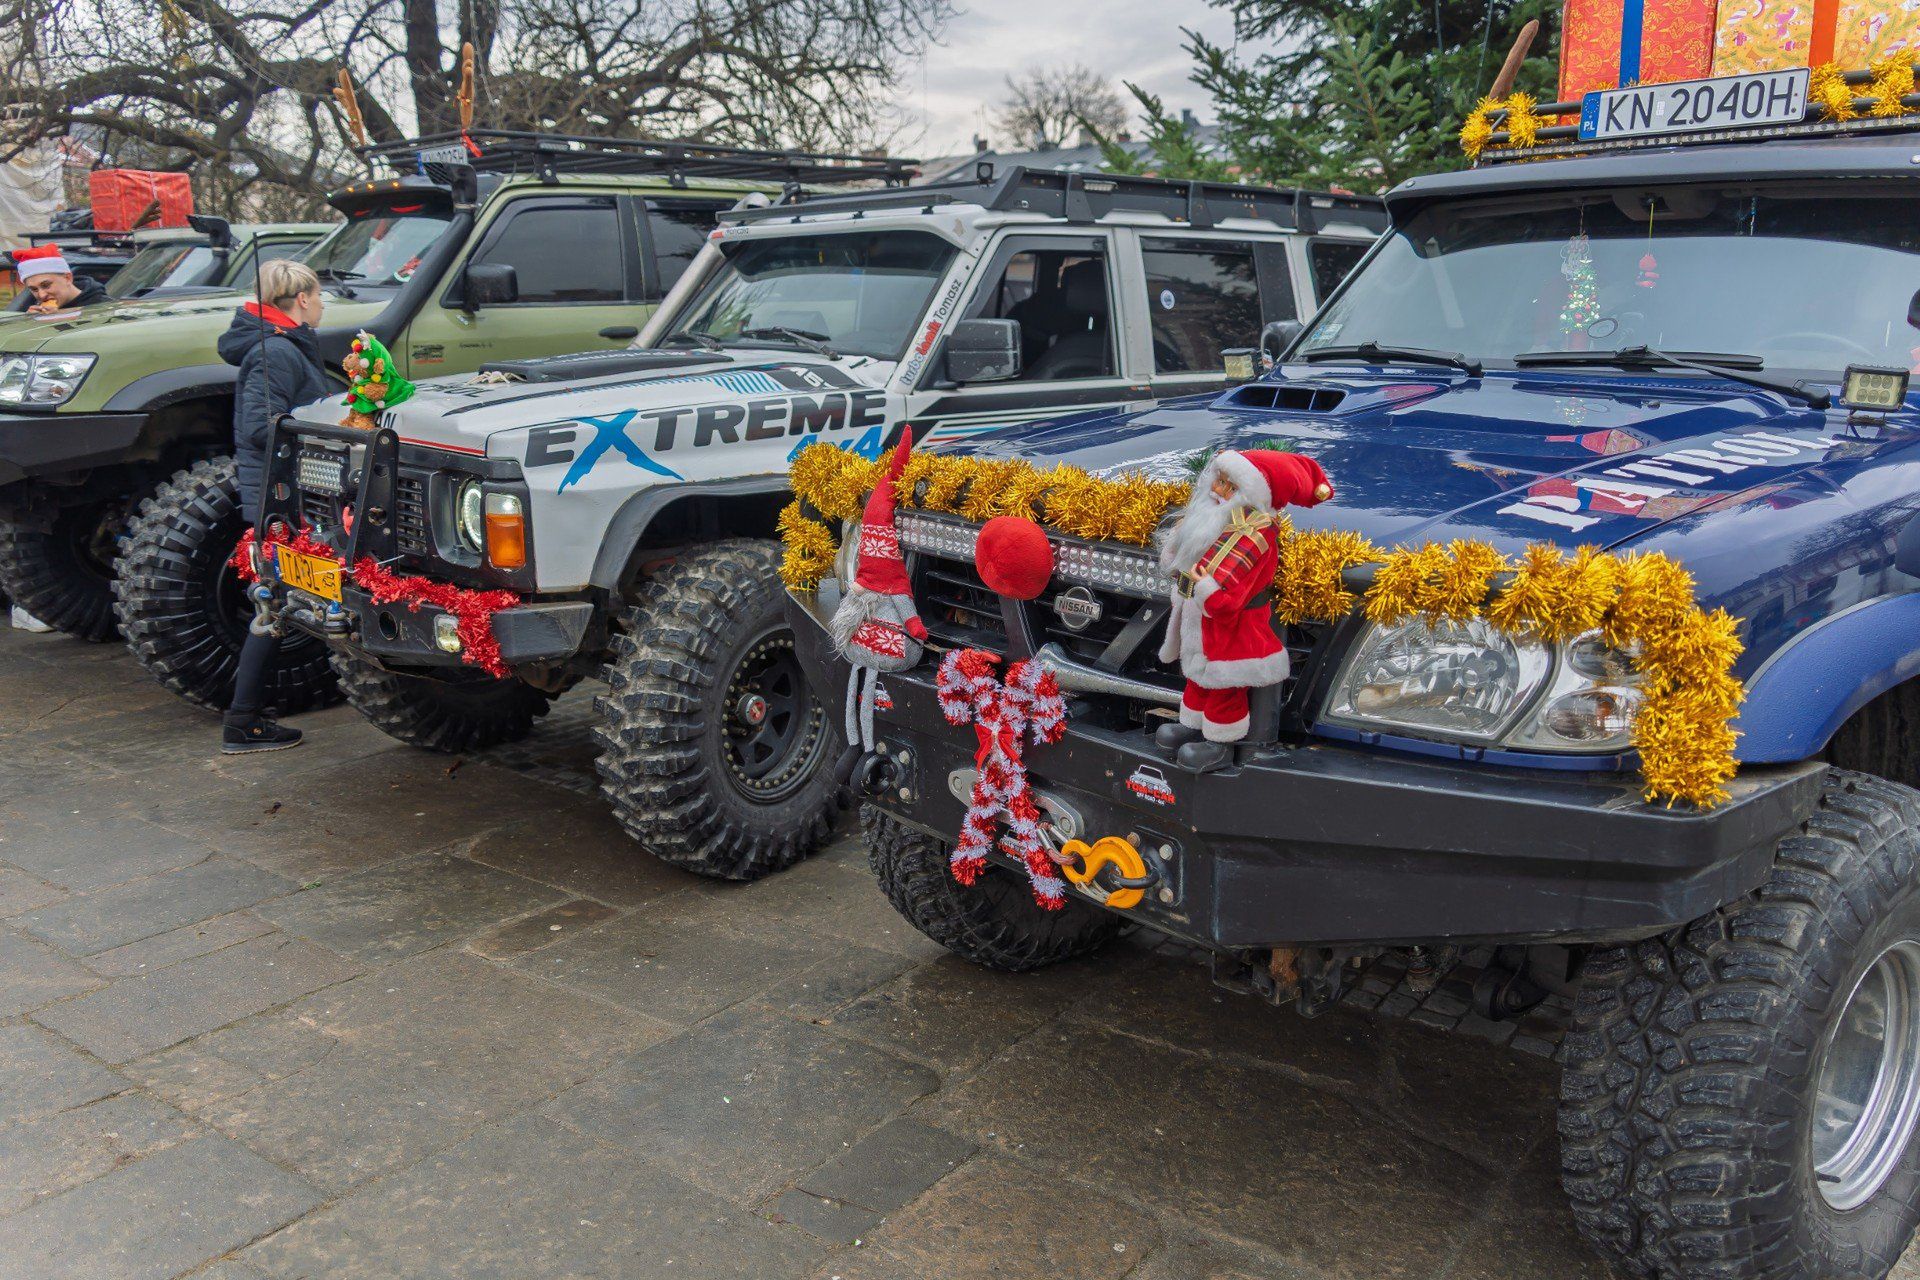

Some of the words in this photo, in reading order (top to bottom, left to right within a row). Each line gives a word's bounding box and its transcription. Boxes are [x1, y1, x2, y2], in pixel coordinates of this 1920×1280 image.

[1583, 121, 1596, 131] PL
[1604, 92, 1655, 132] KN
[1667, 76, 1795, 126] 2040H
[933, 278, 962, 320] Tomasz
[523, 388, 887, 496] EXTREME
[1496, 431, 1848, 533] PATROL
[1059, 598, 1094, 616] NISSAN
